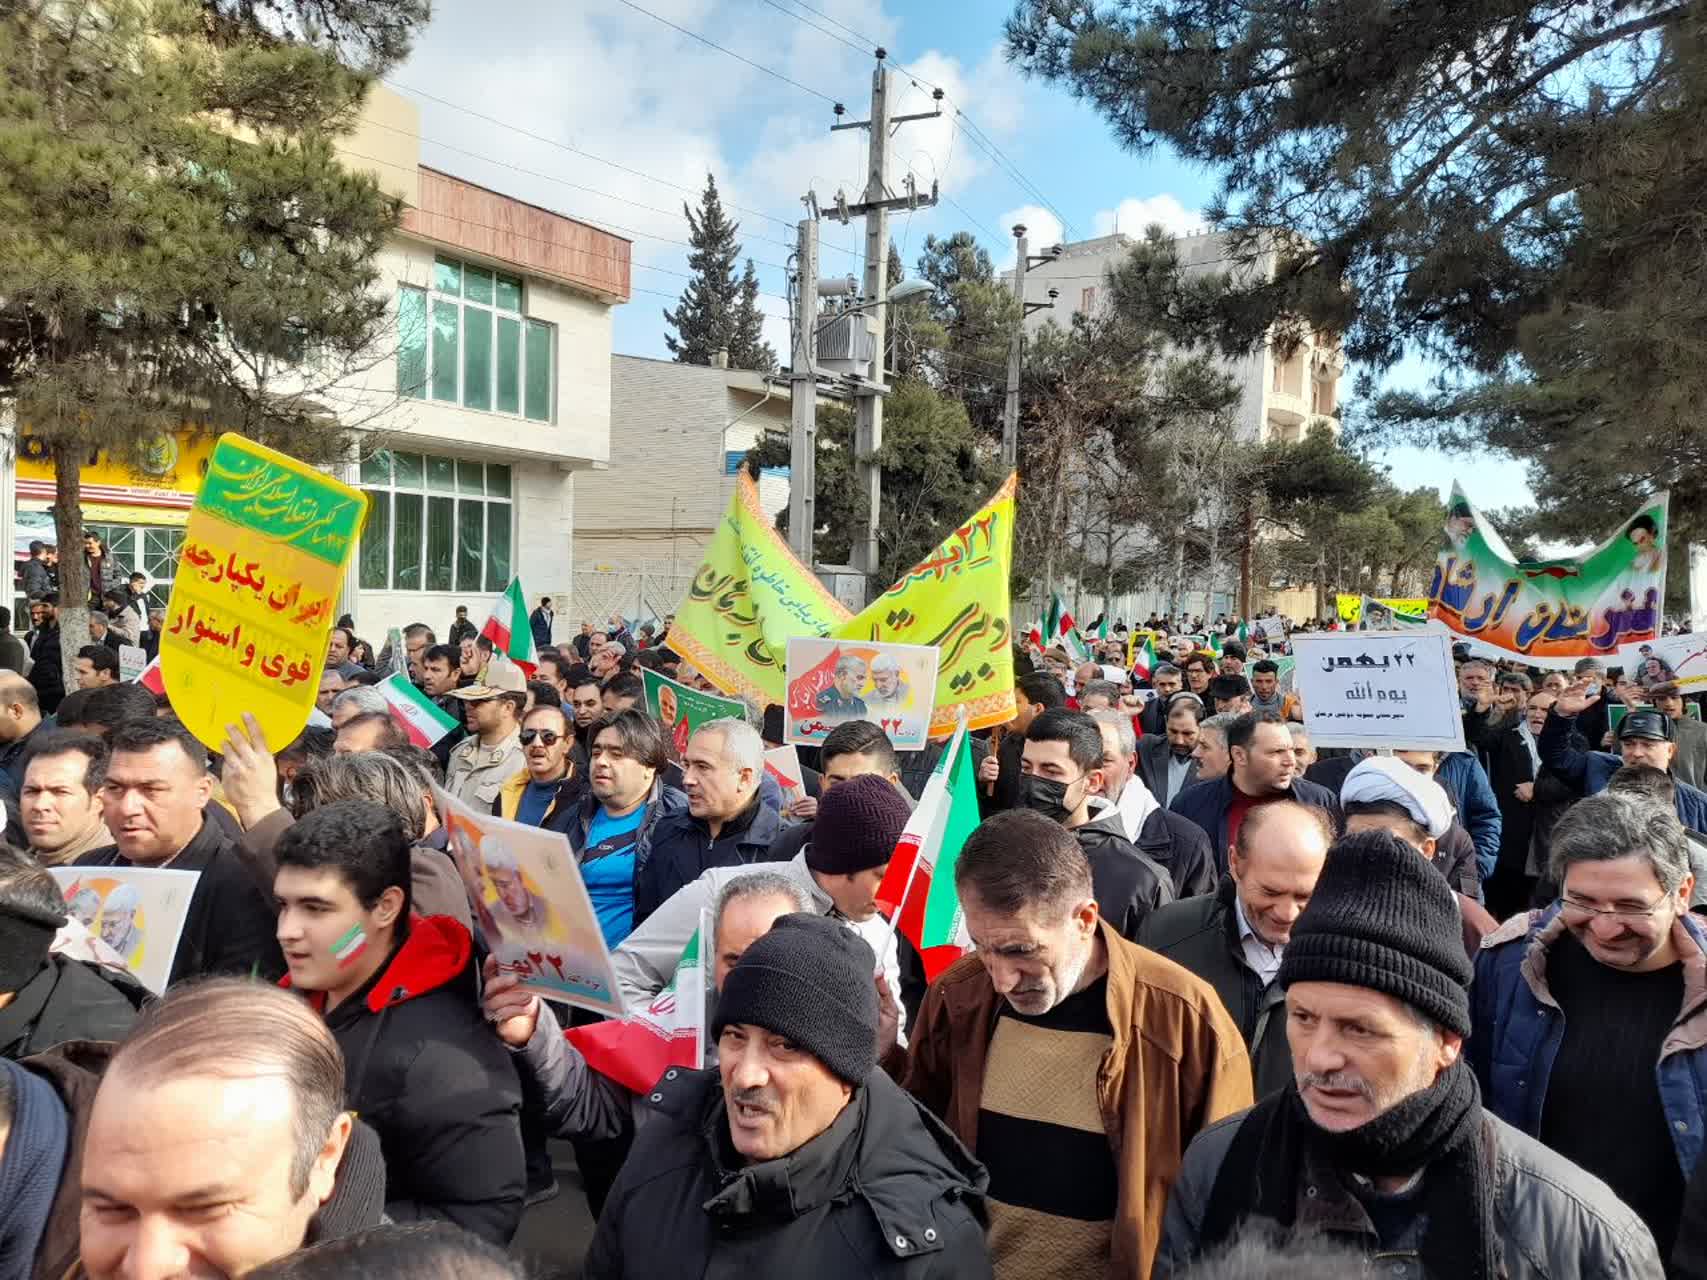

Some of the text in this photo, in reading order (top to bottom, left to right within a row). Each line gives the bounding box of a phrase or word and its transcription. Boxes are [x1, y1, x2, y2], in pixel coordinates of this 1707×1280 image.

[954, 511, 997, 559] ۲۲
[183, 543, 330, 628] ایران یکپارچه
[168, 603, 313, 687] قوی و استوار
[1321, 651, 1415, 673] ۲۲ بهمن
[1377, 688, 1408, 704] یوم
[880, 718, 903, 736] ۲۲
[526, 951, 567, 983] ۲۲
